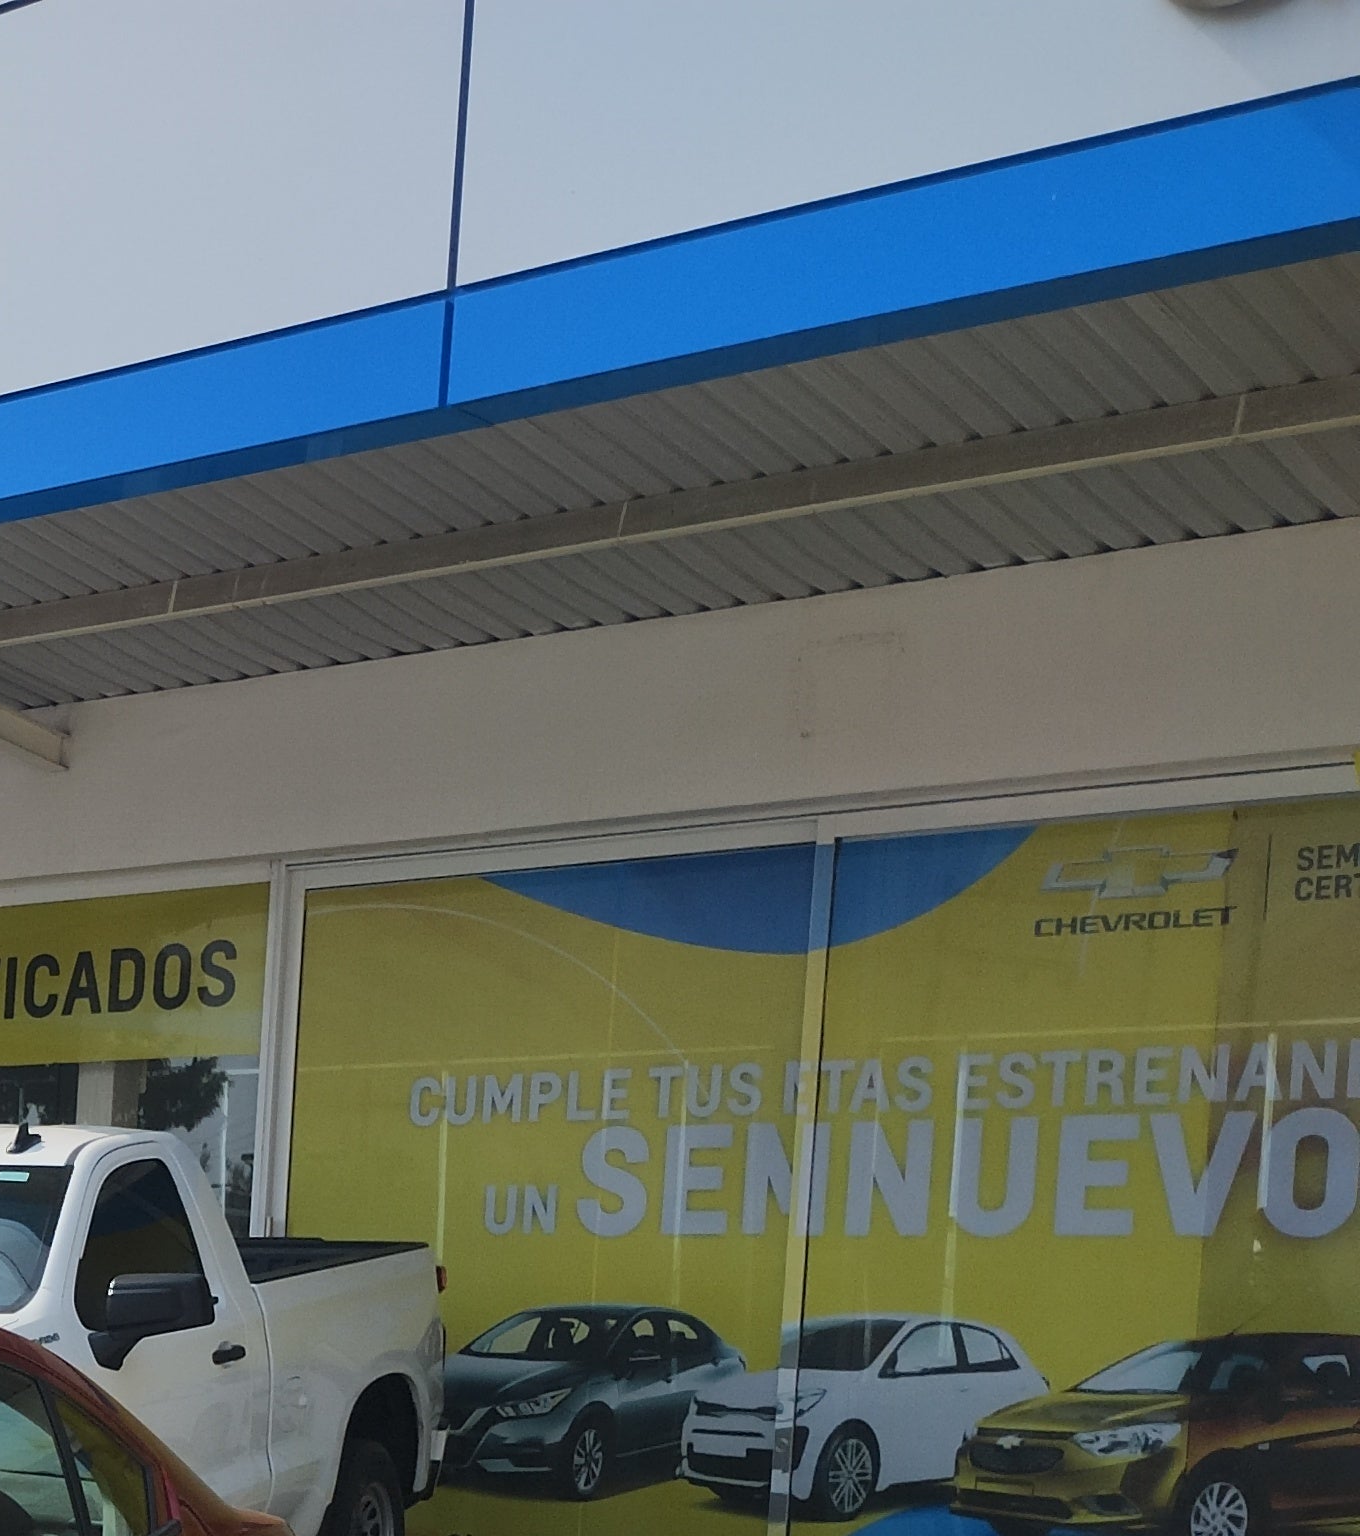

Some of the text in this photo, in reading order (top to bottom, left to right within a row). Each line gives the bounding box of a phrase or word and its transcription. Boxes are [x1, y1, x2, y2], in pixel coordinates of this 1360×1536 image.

[1033, 905, 1238, 938] CHEVROLET
[409, 1068, 633, 1127] CUMPLE
[649, 1062, 763, 1118] TUS
[483, 1184, 559, 1236] UN
